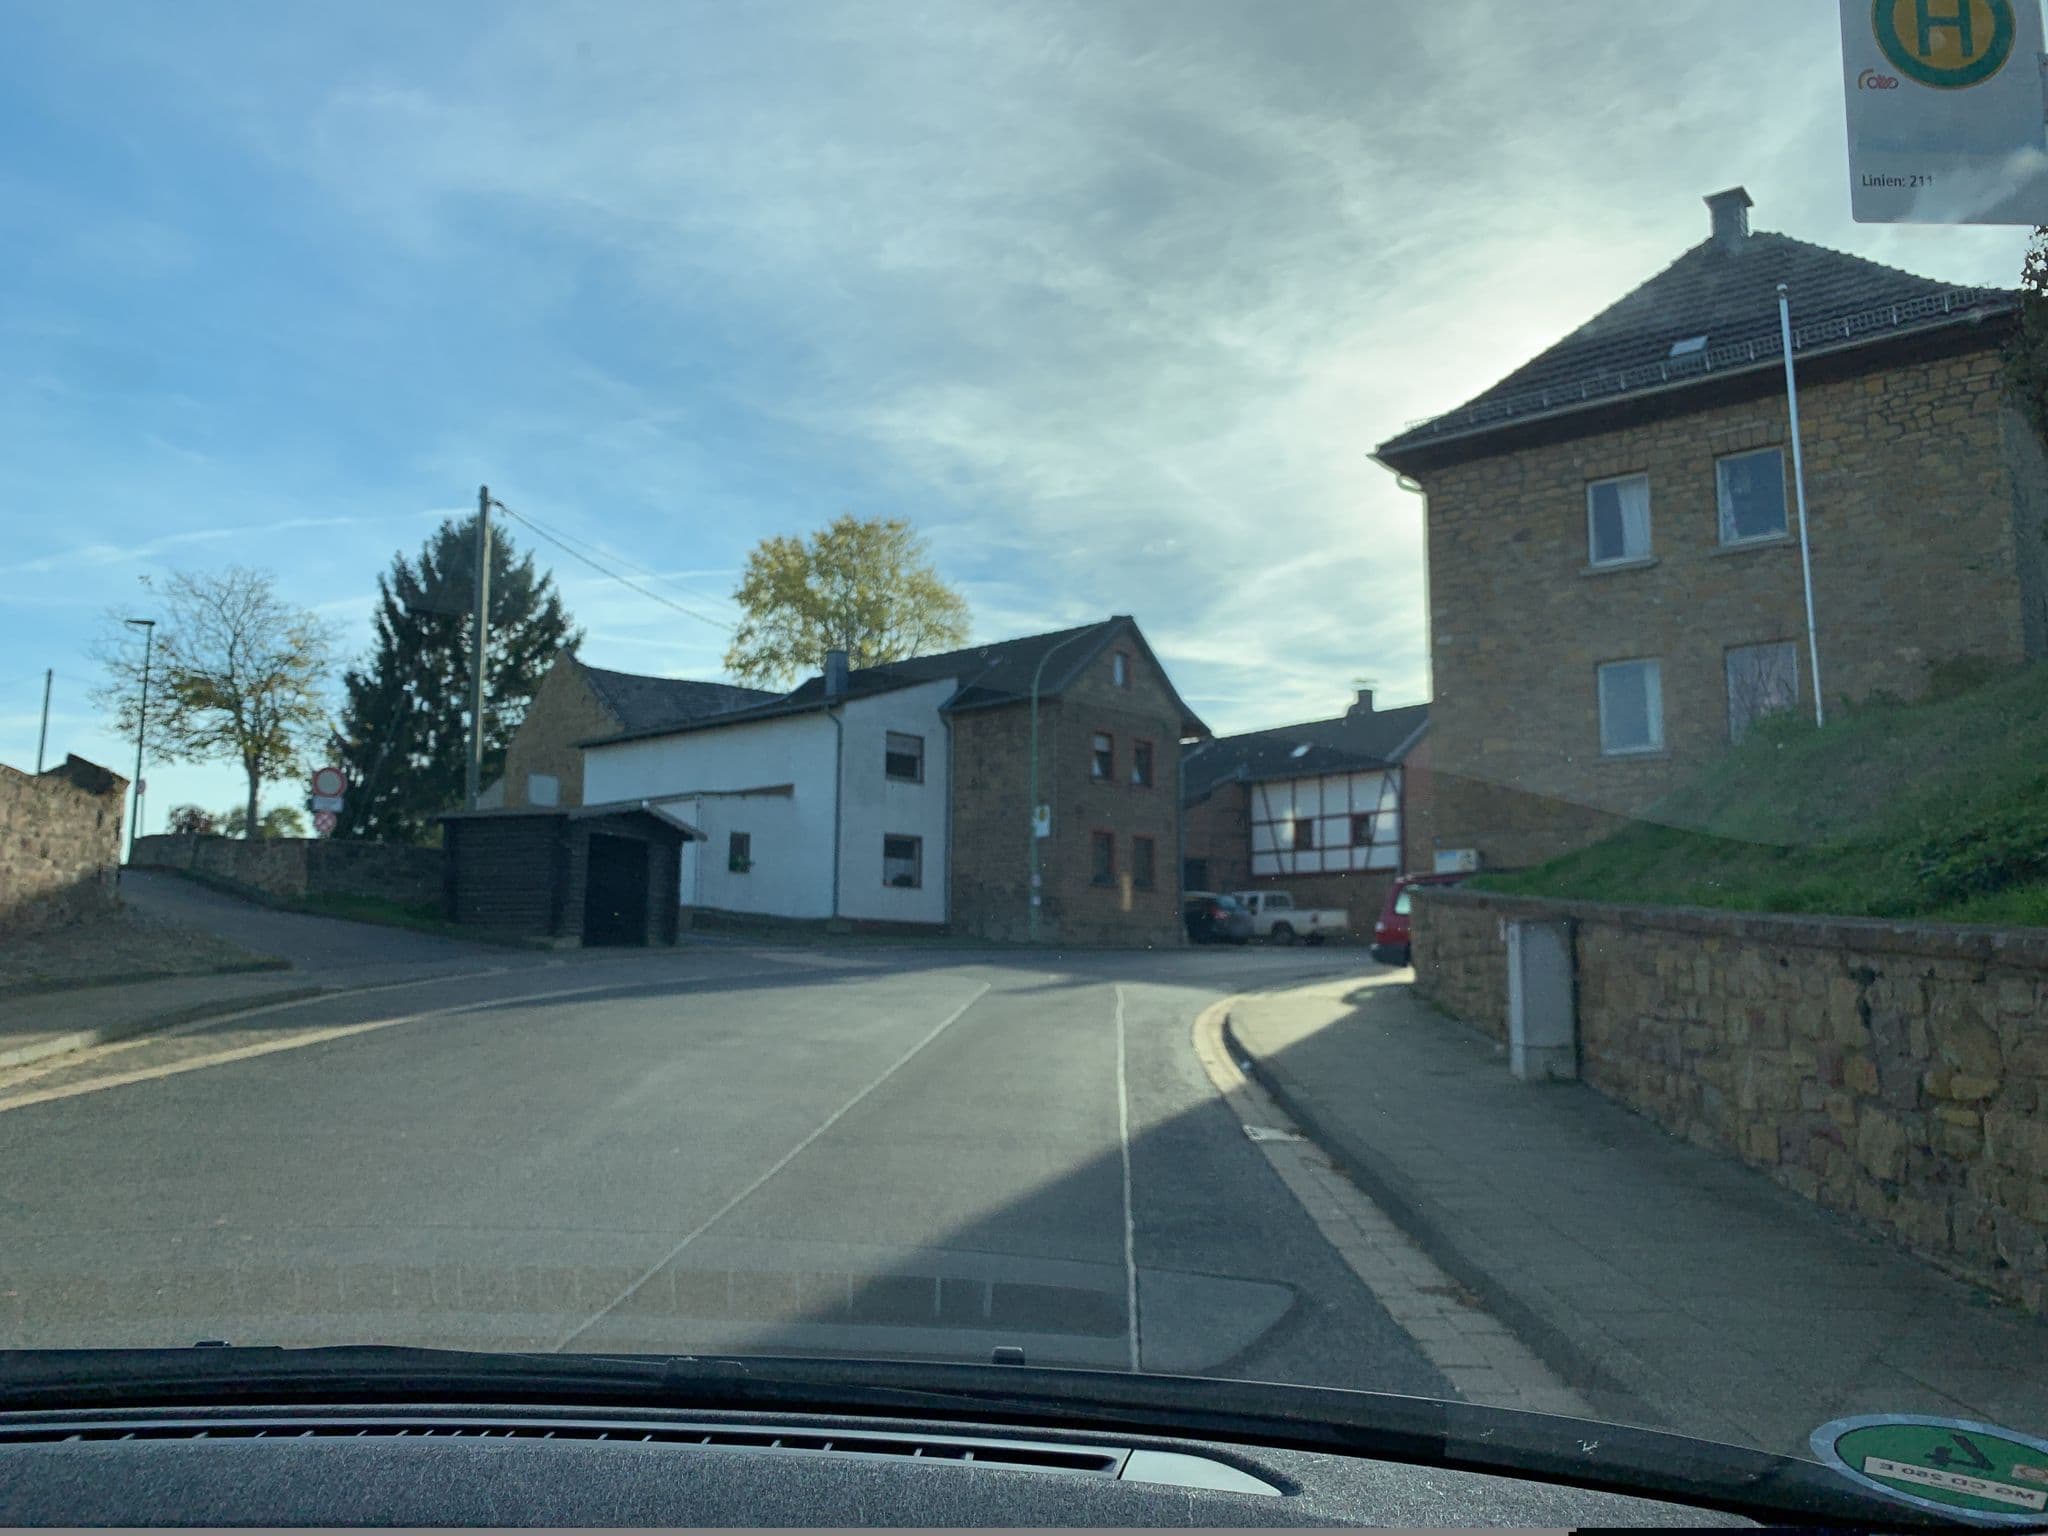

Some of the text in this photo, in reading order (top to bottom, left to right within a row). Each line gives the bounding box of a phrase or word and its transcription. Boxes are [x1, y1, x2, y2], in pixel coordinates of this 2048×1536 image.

[1915, 0, 1974, 57] H
[1862, 173, 1933, 188] Linien: 211
